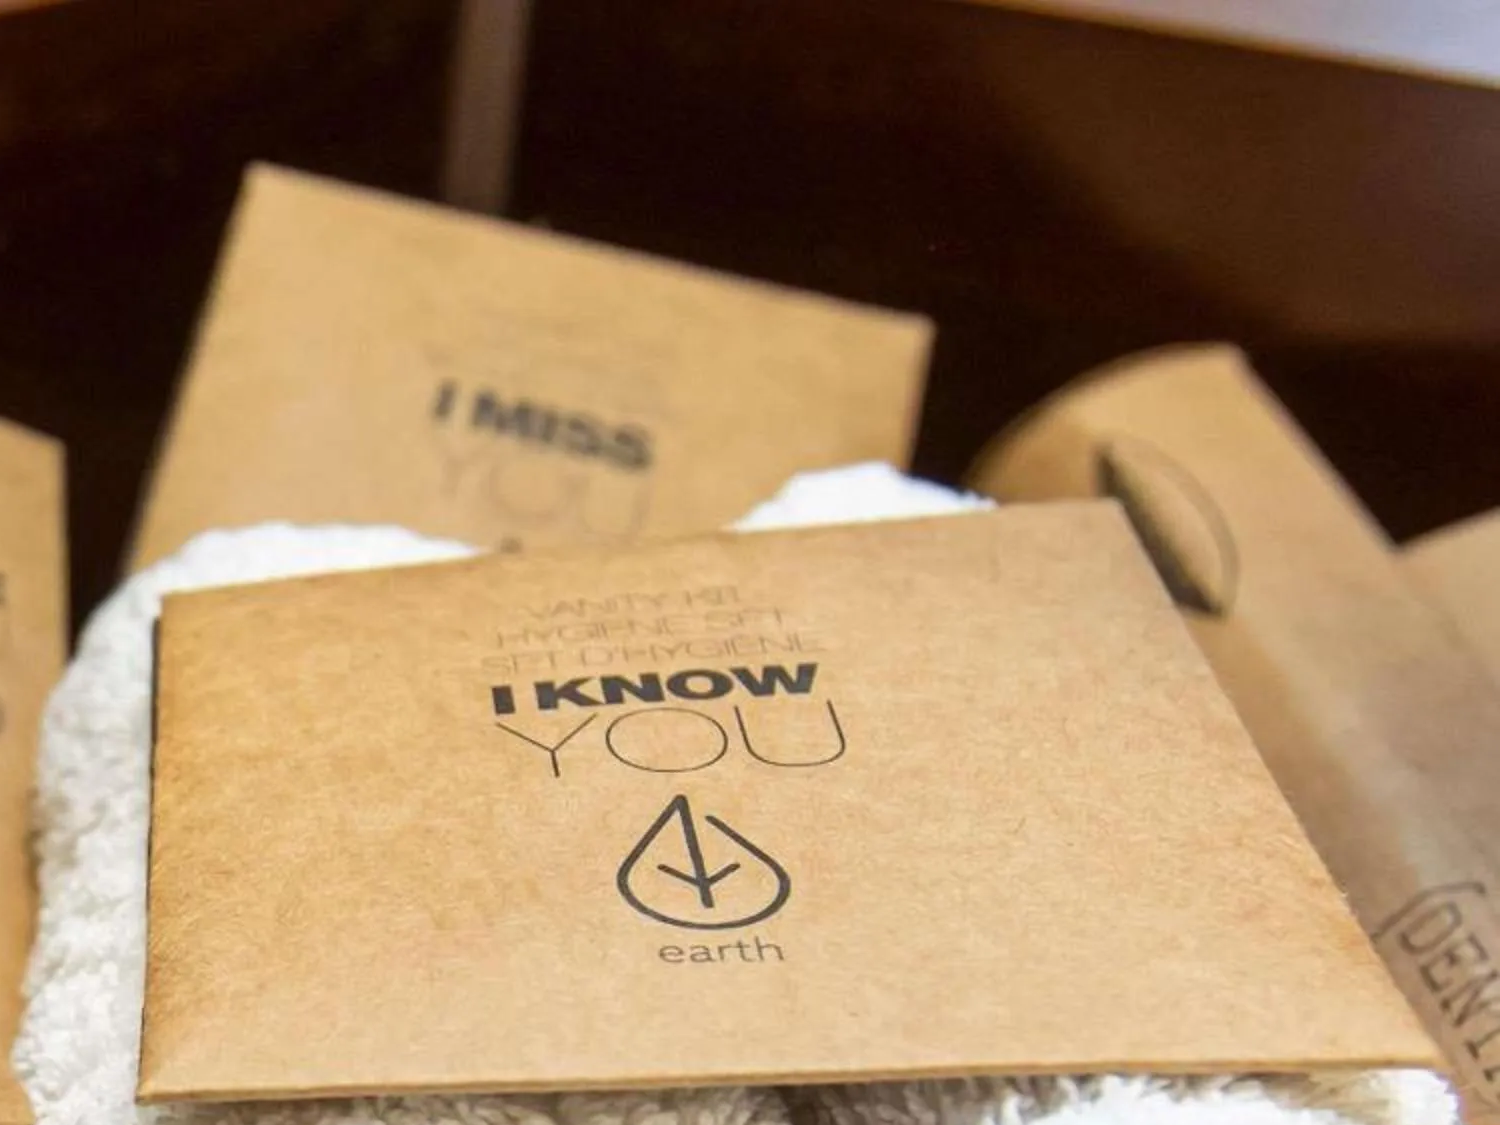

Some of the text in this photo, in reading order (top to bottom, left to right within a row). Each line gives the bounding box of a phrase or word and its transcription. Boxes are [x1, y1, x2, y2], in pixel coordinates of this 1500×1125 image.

[432, 378, 656, 476] I MISS
[490, 662, 818, 716] I KNOW
[495, 700, 846, 778] YOU
[659, 936, 785, 964] earth
